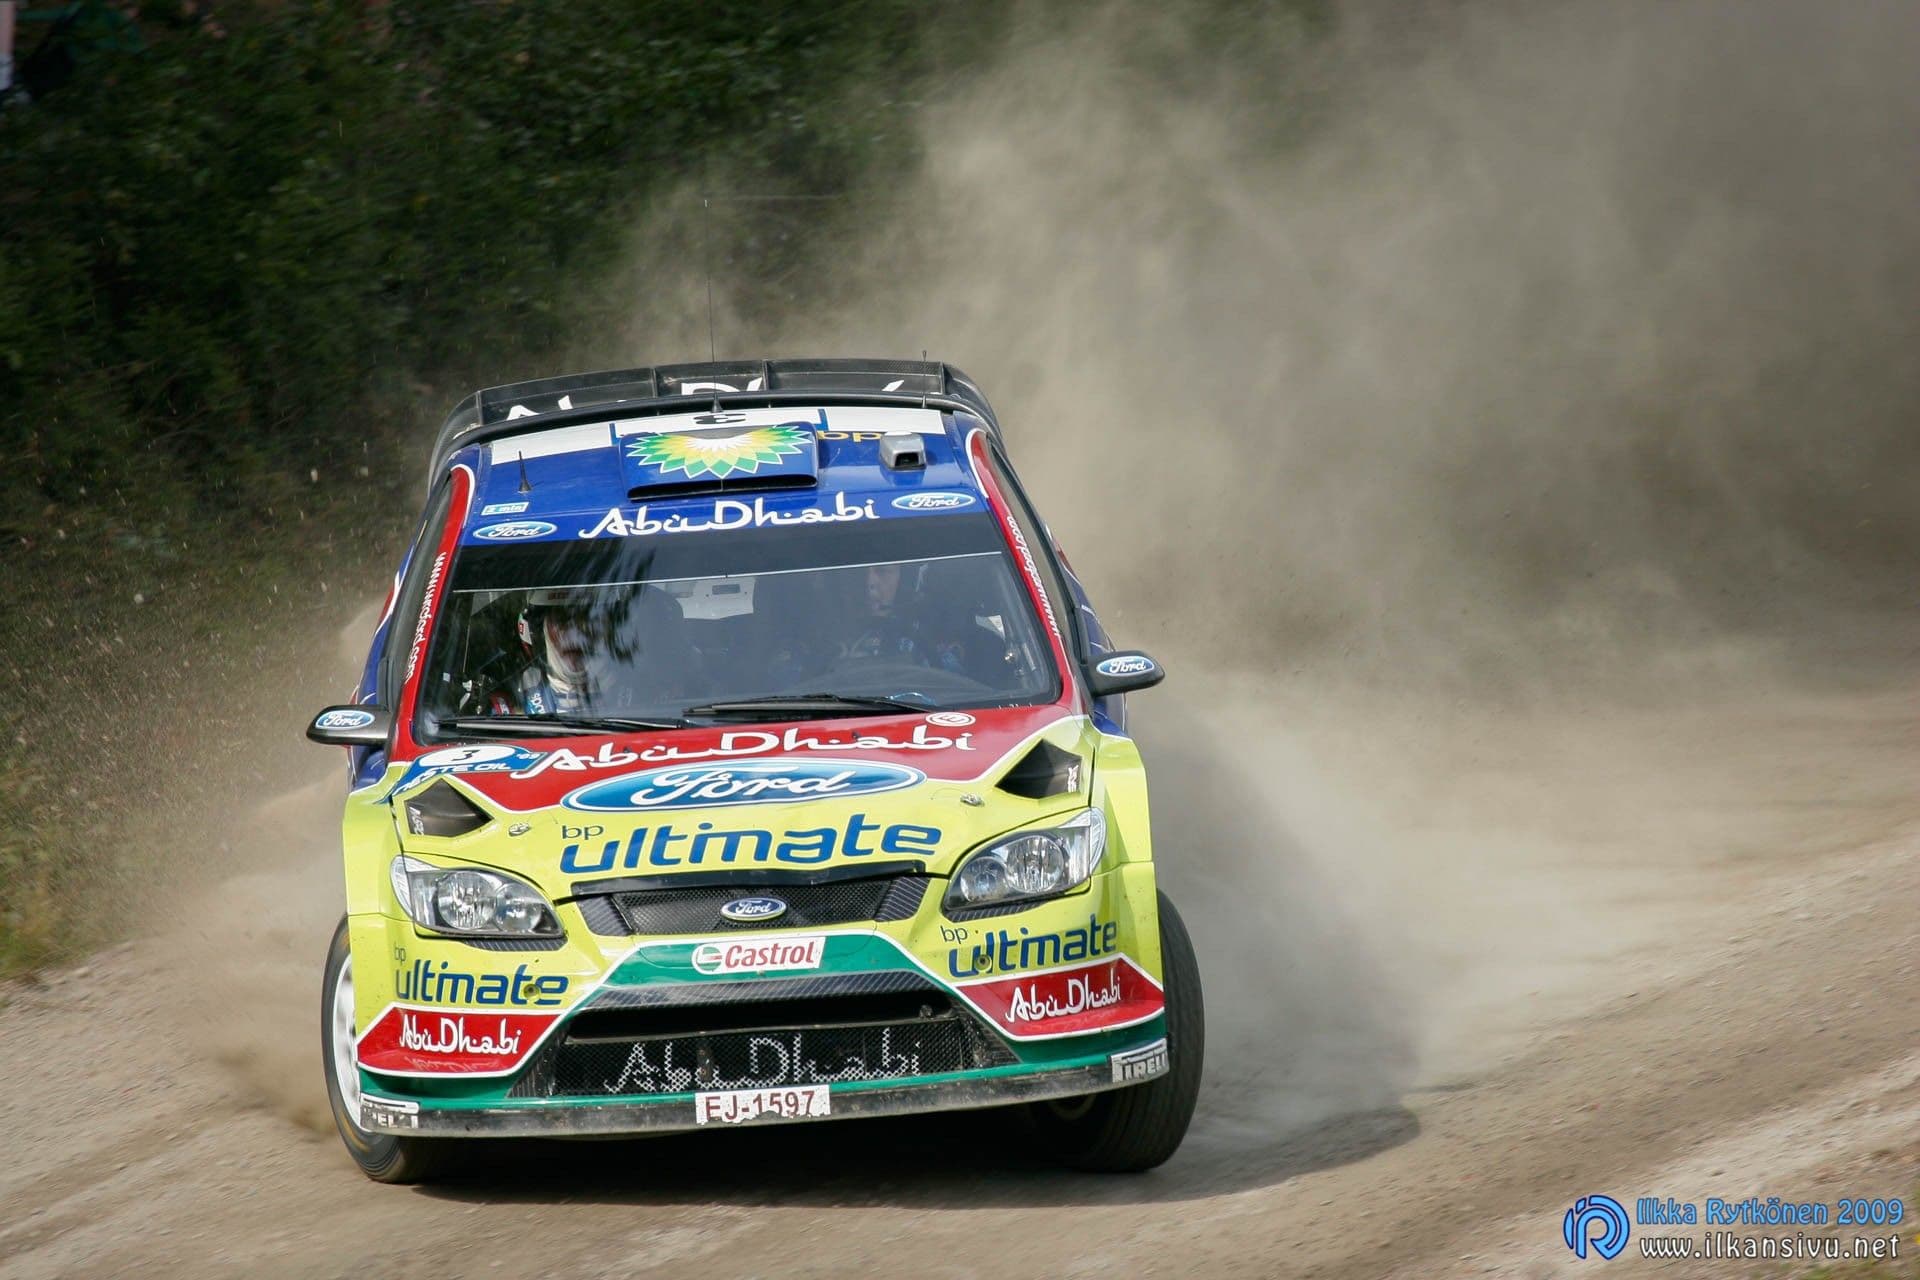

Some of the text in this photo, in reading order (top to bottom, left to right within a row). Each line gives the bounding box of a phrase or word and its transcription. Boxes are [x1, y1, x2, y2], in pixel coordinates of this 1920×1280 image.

[908, 495, 960, 508] Ford
[487, 525, 542, 538] Ford
[1109, 658, 1147, 674] Ford
[322, 712, 364, 726] Ford
[452, 749, 481, 761] 3
[474, 761, 512, 771] OIL
[630, 765, 857, 806] Ford
[562, 823, 604, 842] bp
[559, 812, 943, 874] ultimate
[735, 900, 772, 914] Ford
[940, 924, 969, 945] bp
[394, 943, 407, 964] bp
[948, 912, 1118, 978] ultimate
[724, 941, 815, 970] Castrol
[396, 959, 570, 1006] ultimate
